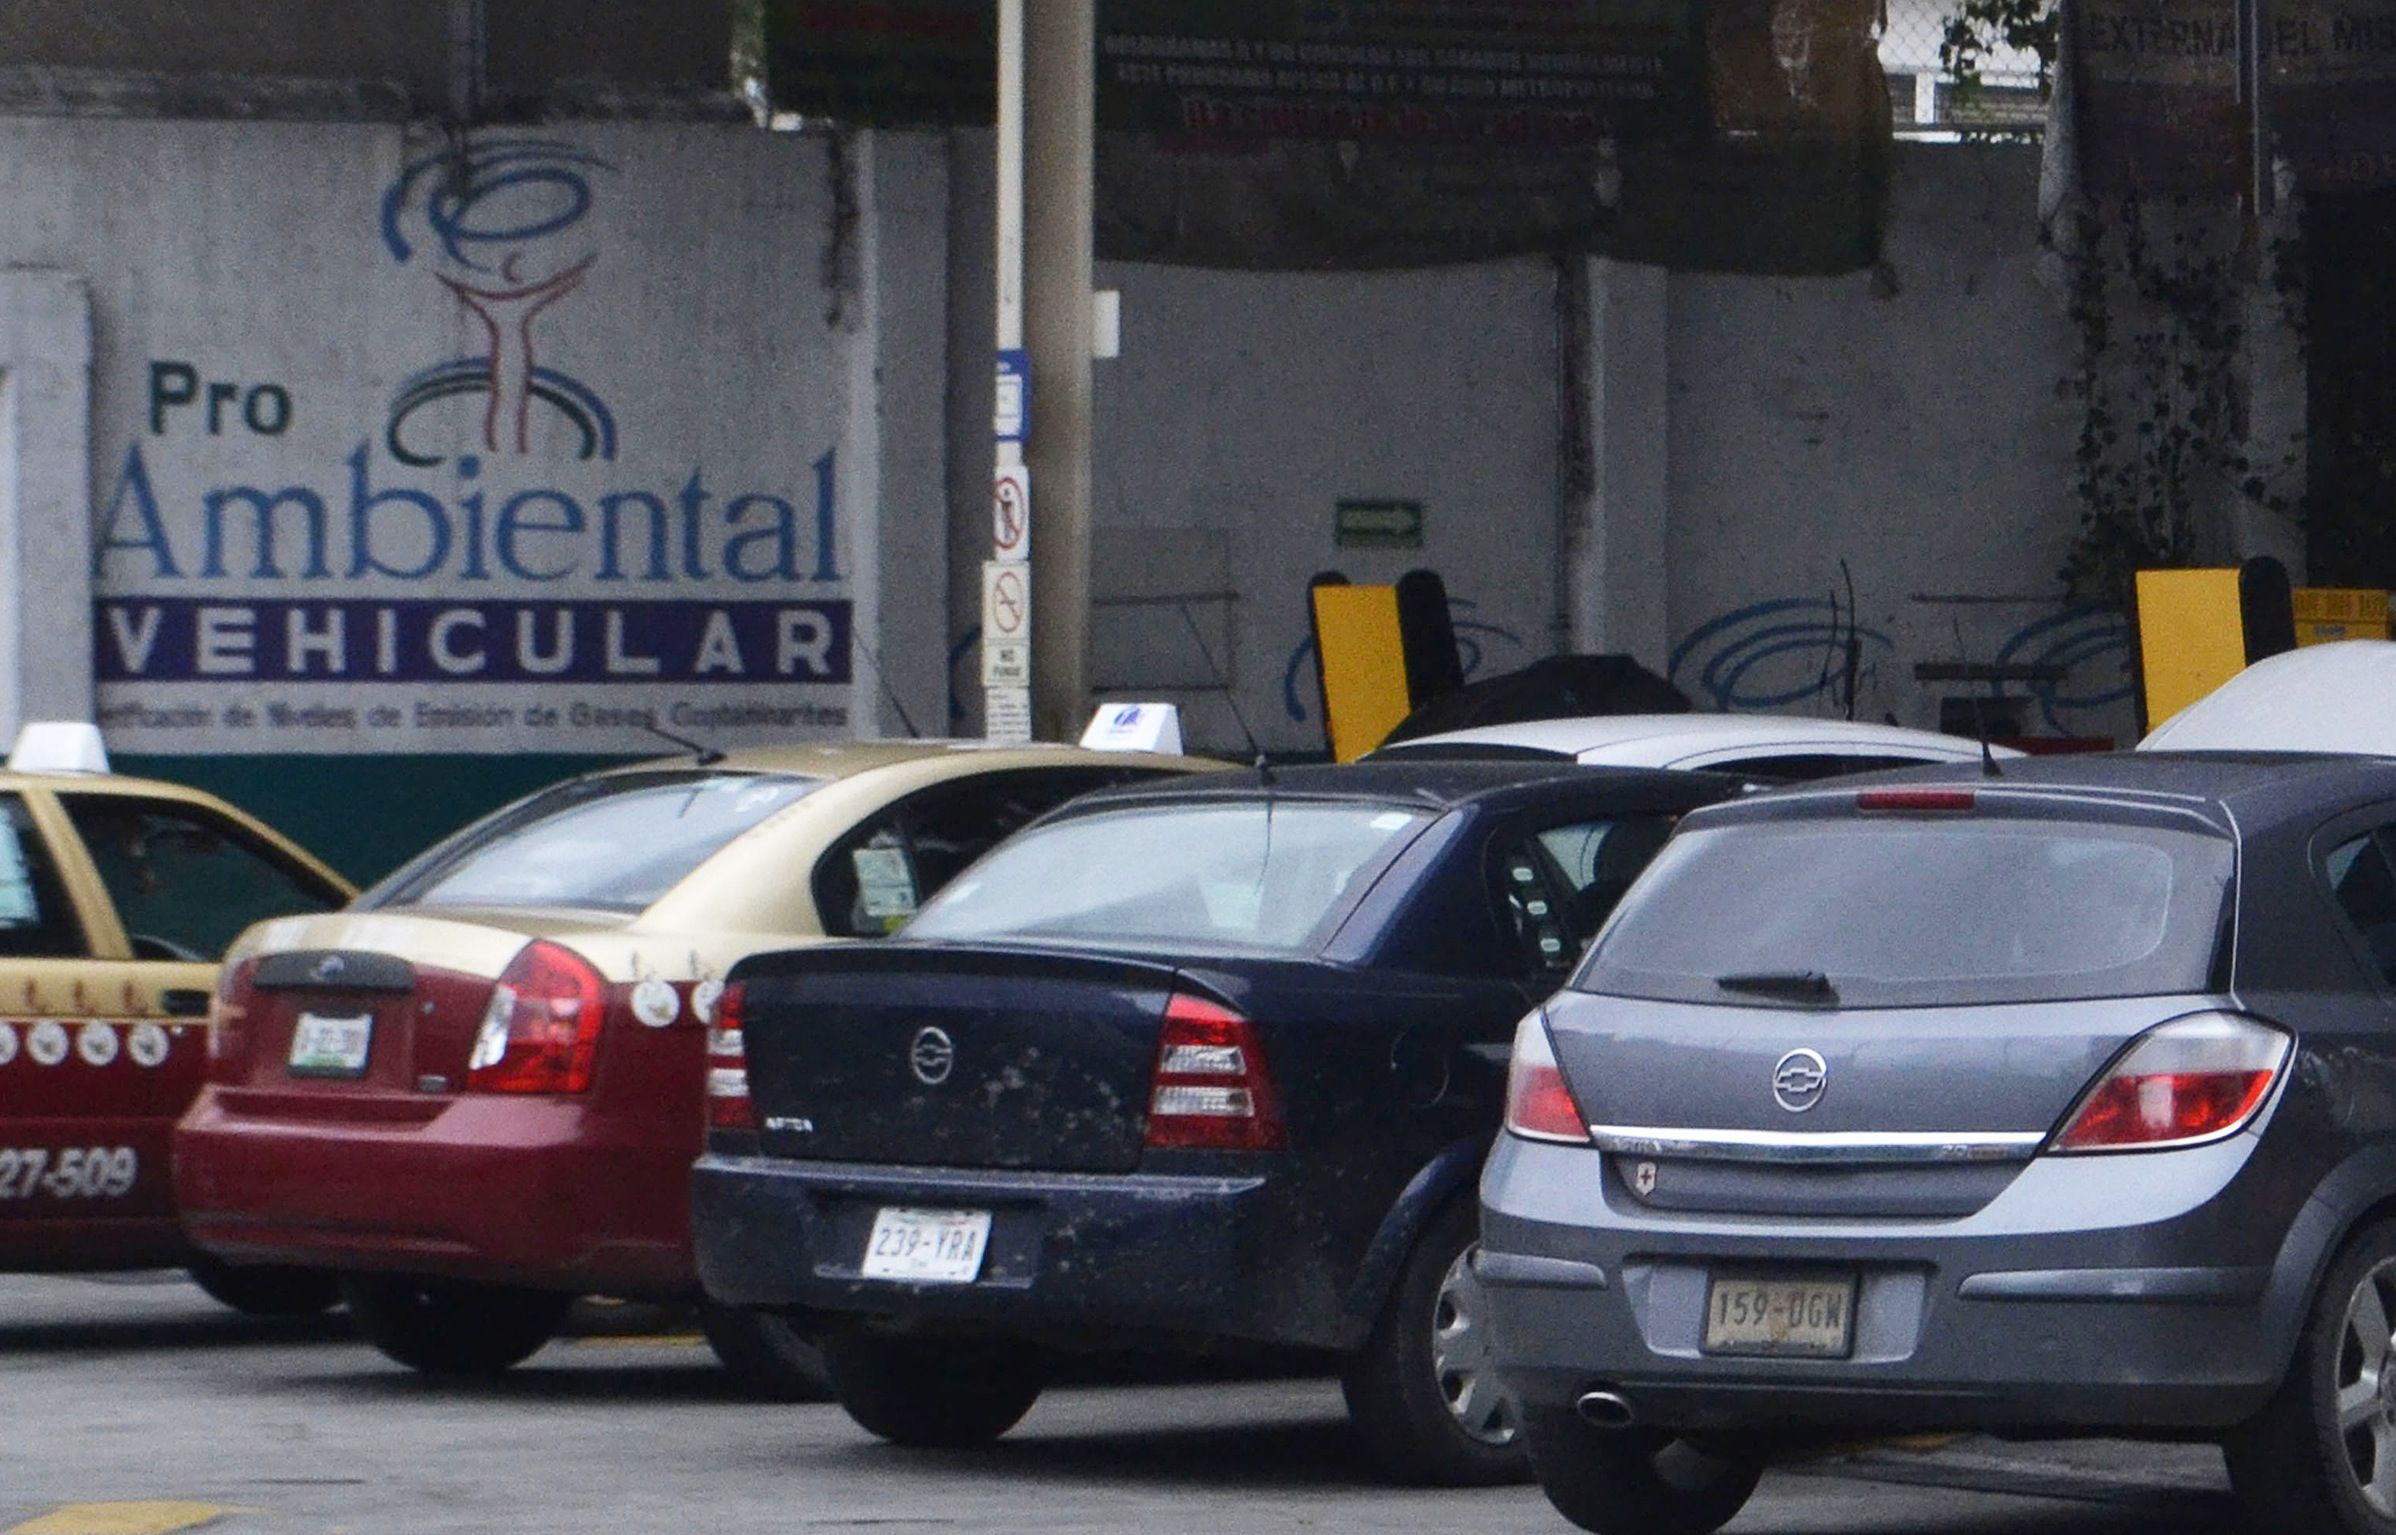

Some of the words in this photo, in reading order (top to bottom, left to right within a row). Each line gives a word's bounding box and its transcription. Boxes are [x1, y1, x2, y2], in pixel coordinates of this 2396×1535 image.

[149, 360, 291, 436] Pro
[94, 441, 843, 581] Ambiental
[107, 608, 834, 675] VEHICULAR
[222, 706, 254, 728] de
[366, 706, 402, 729] de
[524, 704, 556, 727] de
